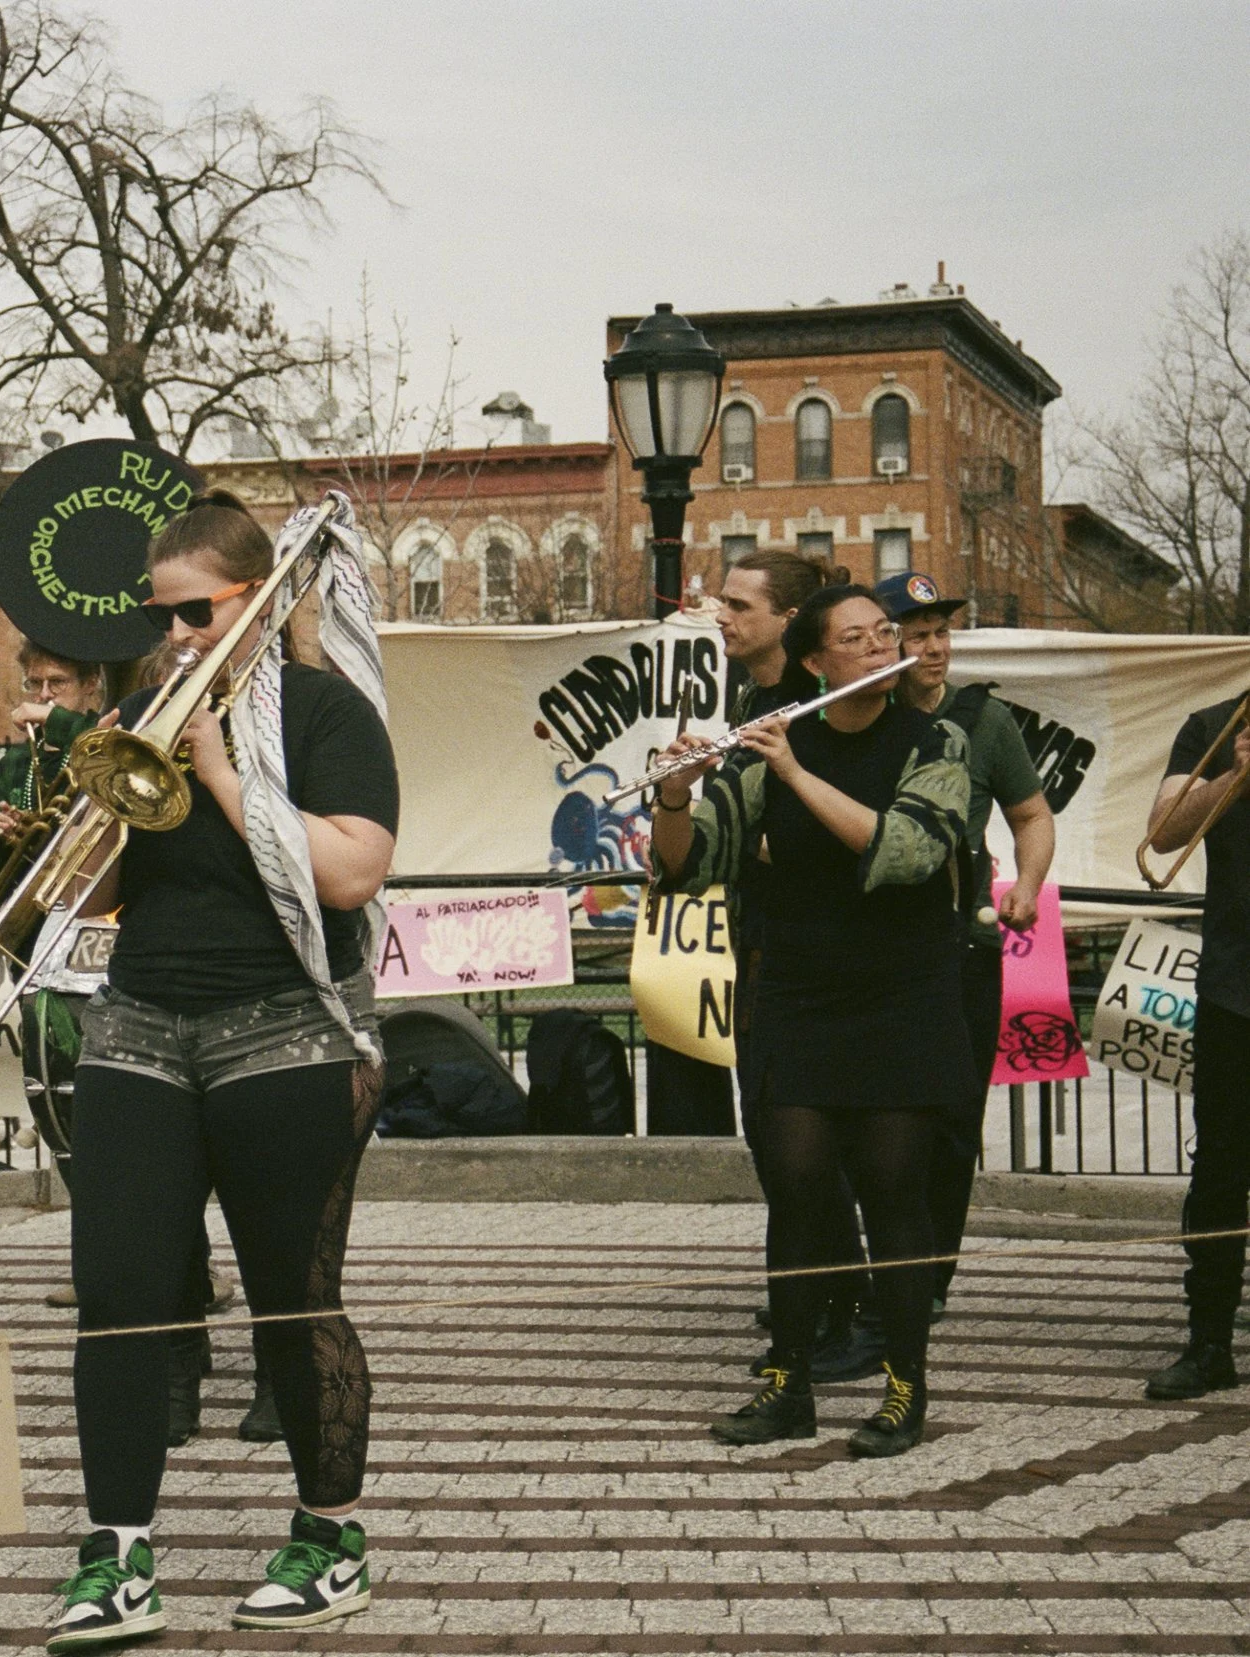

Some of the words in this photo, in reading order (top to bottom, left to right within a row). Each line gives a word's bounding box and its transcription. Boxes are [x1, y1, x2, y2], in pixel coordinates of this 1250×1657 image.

[120, 451, 193, 517] RUD
[30, 517, 139, 616] ORCHESTRA
[1000, 697, 1097, 815] MOS
[416, 907, 430, 920] AL
[660, 894, 728, 956] ICE
[69, 931, 117, 968] RE
[493, 968, 537, 982] NOW!
[1105, 982, 1128, 1010] A
[1140, 986, 1196, 1031] TOD
